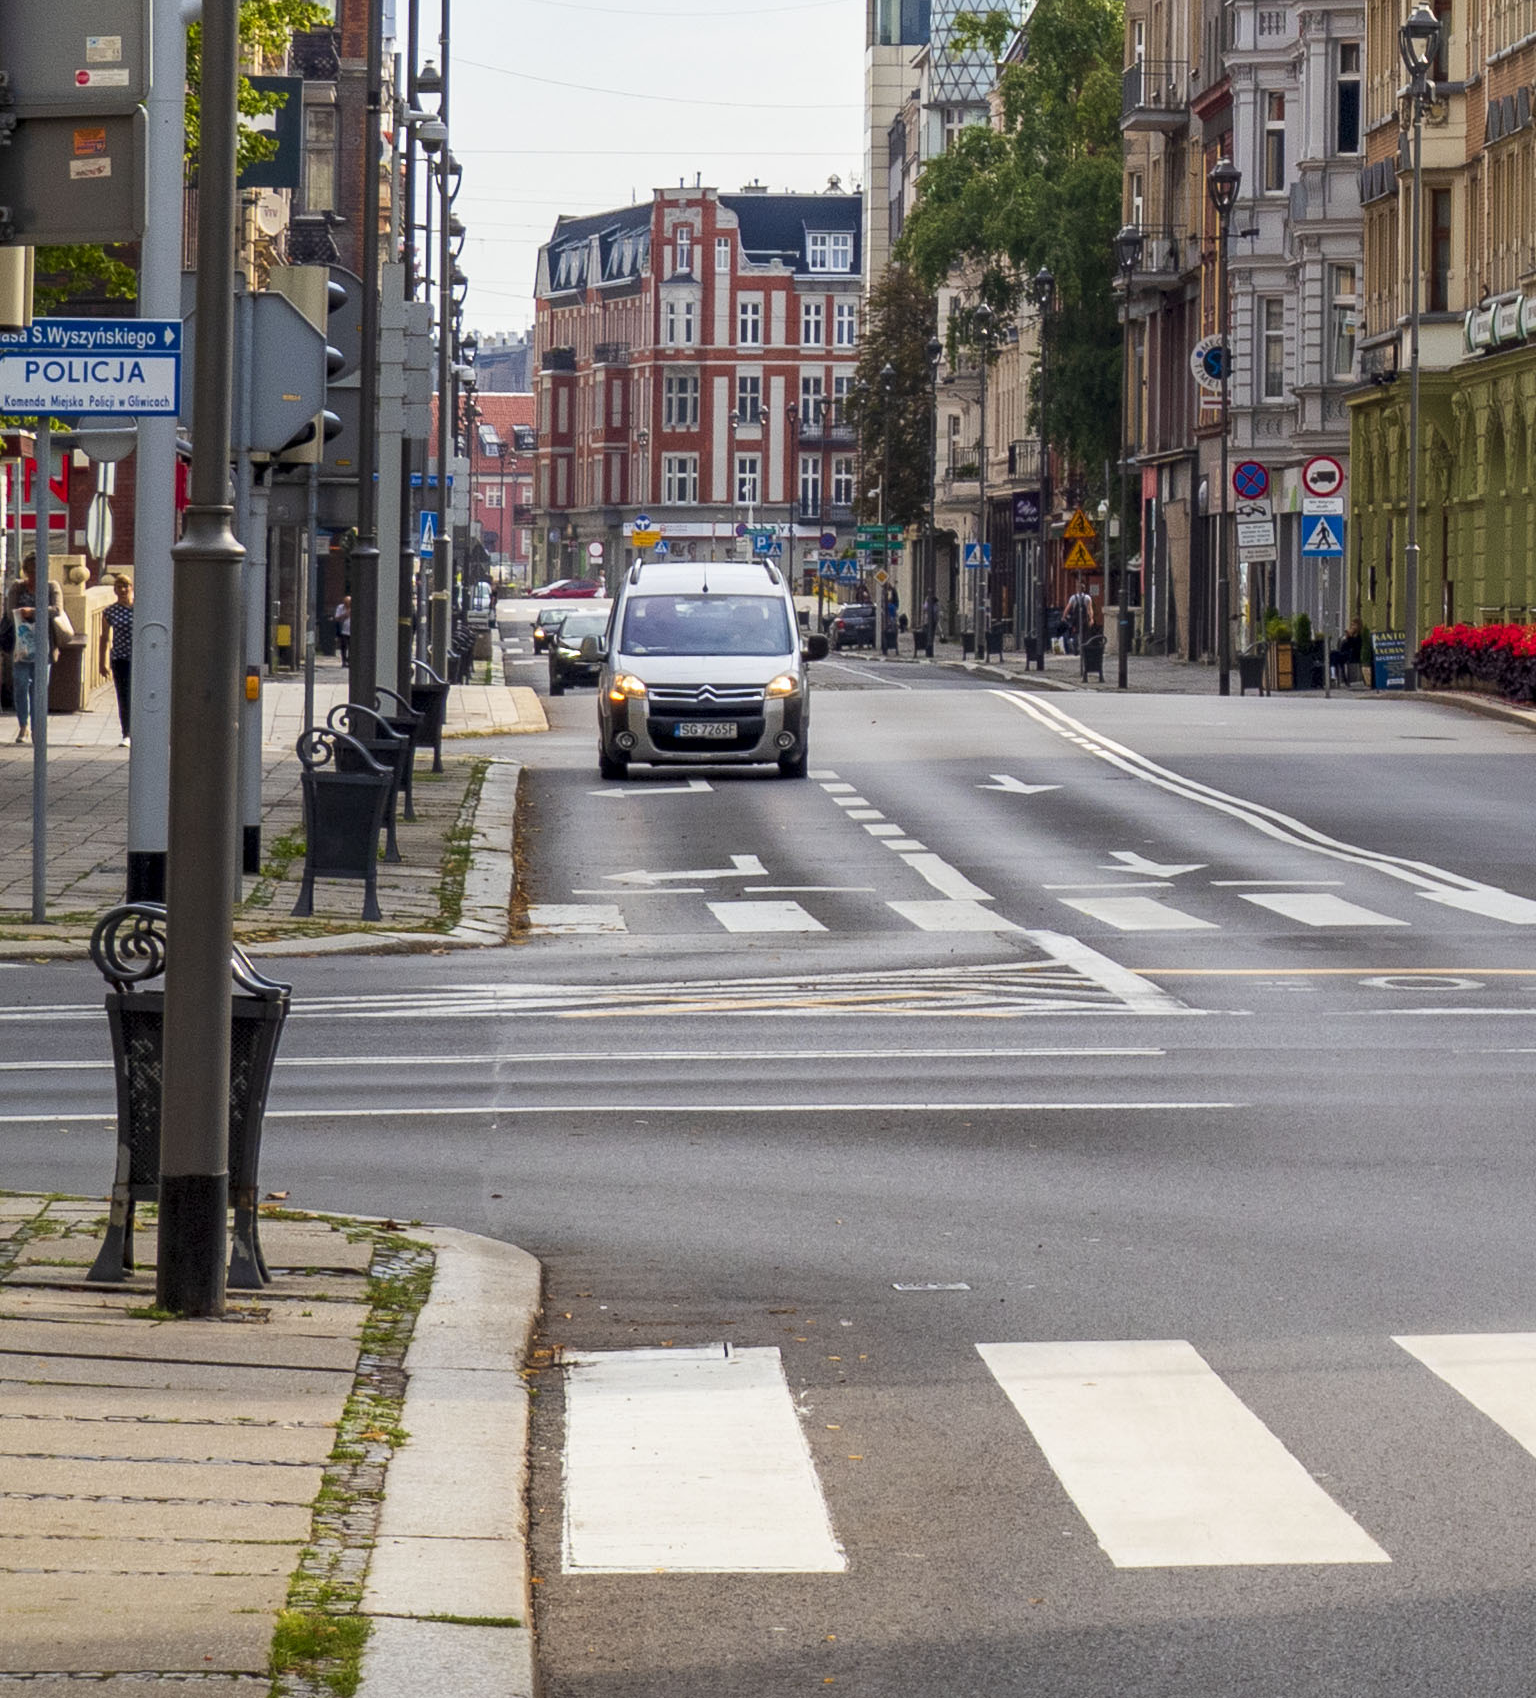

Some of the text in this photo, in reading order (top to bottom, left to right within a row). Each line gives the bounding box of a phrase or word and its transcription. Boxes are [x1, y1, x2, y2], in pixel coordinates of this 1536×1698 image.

[0, 326, 156, 349] asa S.Wyszyńskiego
[25, 361, 146, 384] POLICJA
[4, 394, 170, 411] Komenda Miejska Policji w Gliwicach
[1375, 632, 1406, 641] KANTO
[681, 724, 698, 736] SG
